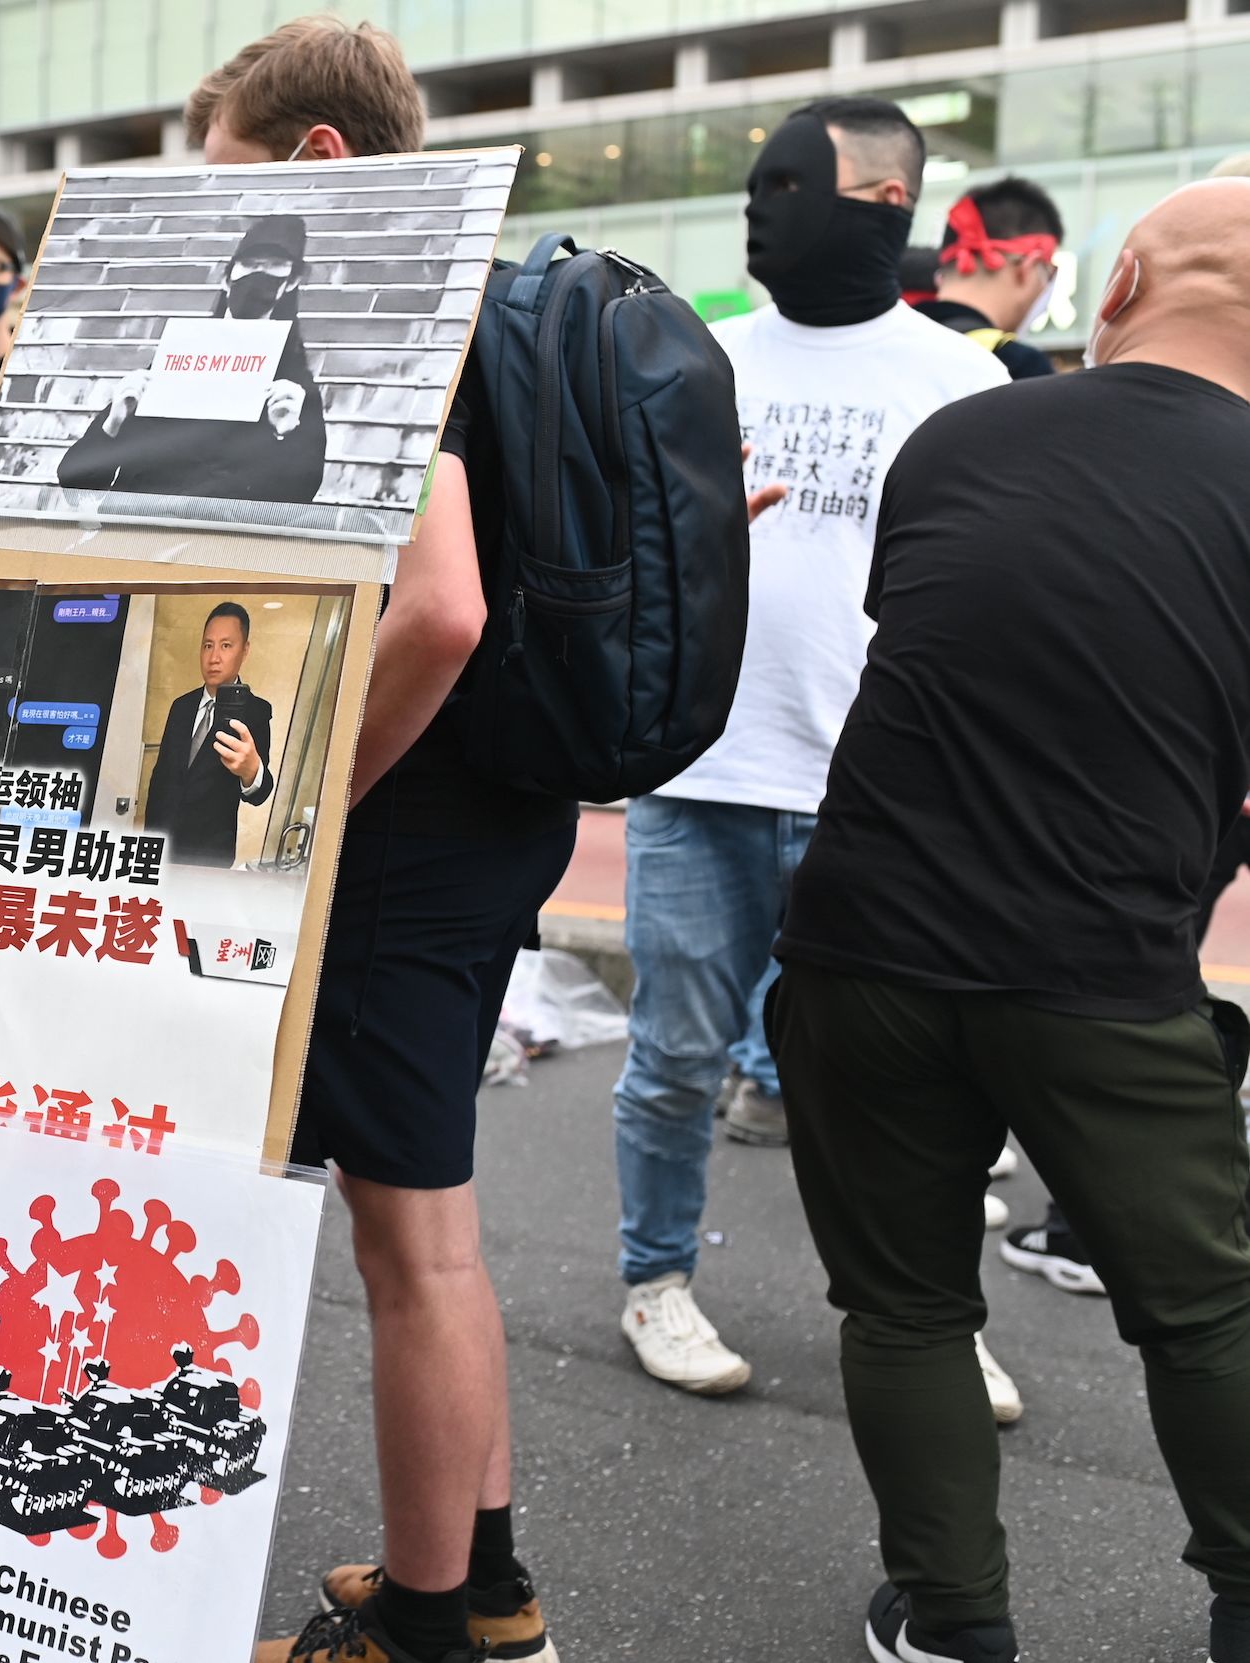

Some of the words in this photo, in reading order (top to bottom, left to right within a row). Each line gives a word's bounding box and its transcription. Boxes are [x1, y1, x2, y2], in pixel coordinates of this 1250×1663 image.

[164, 354, 193, 371] THIS
[193, 355, 208, 371] IS
[209, 355, 232, 372] MY
[231, 355, 267, 373] DUTY
[751, 484, 869, 520] 自由的
[216, 938, 277, 971] 星洲网
